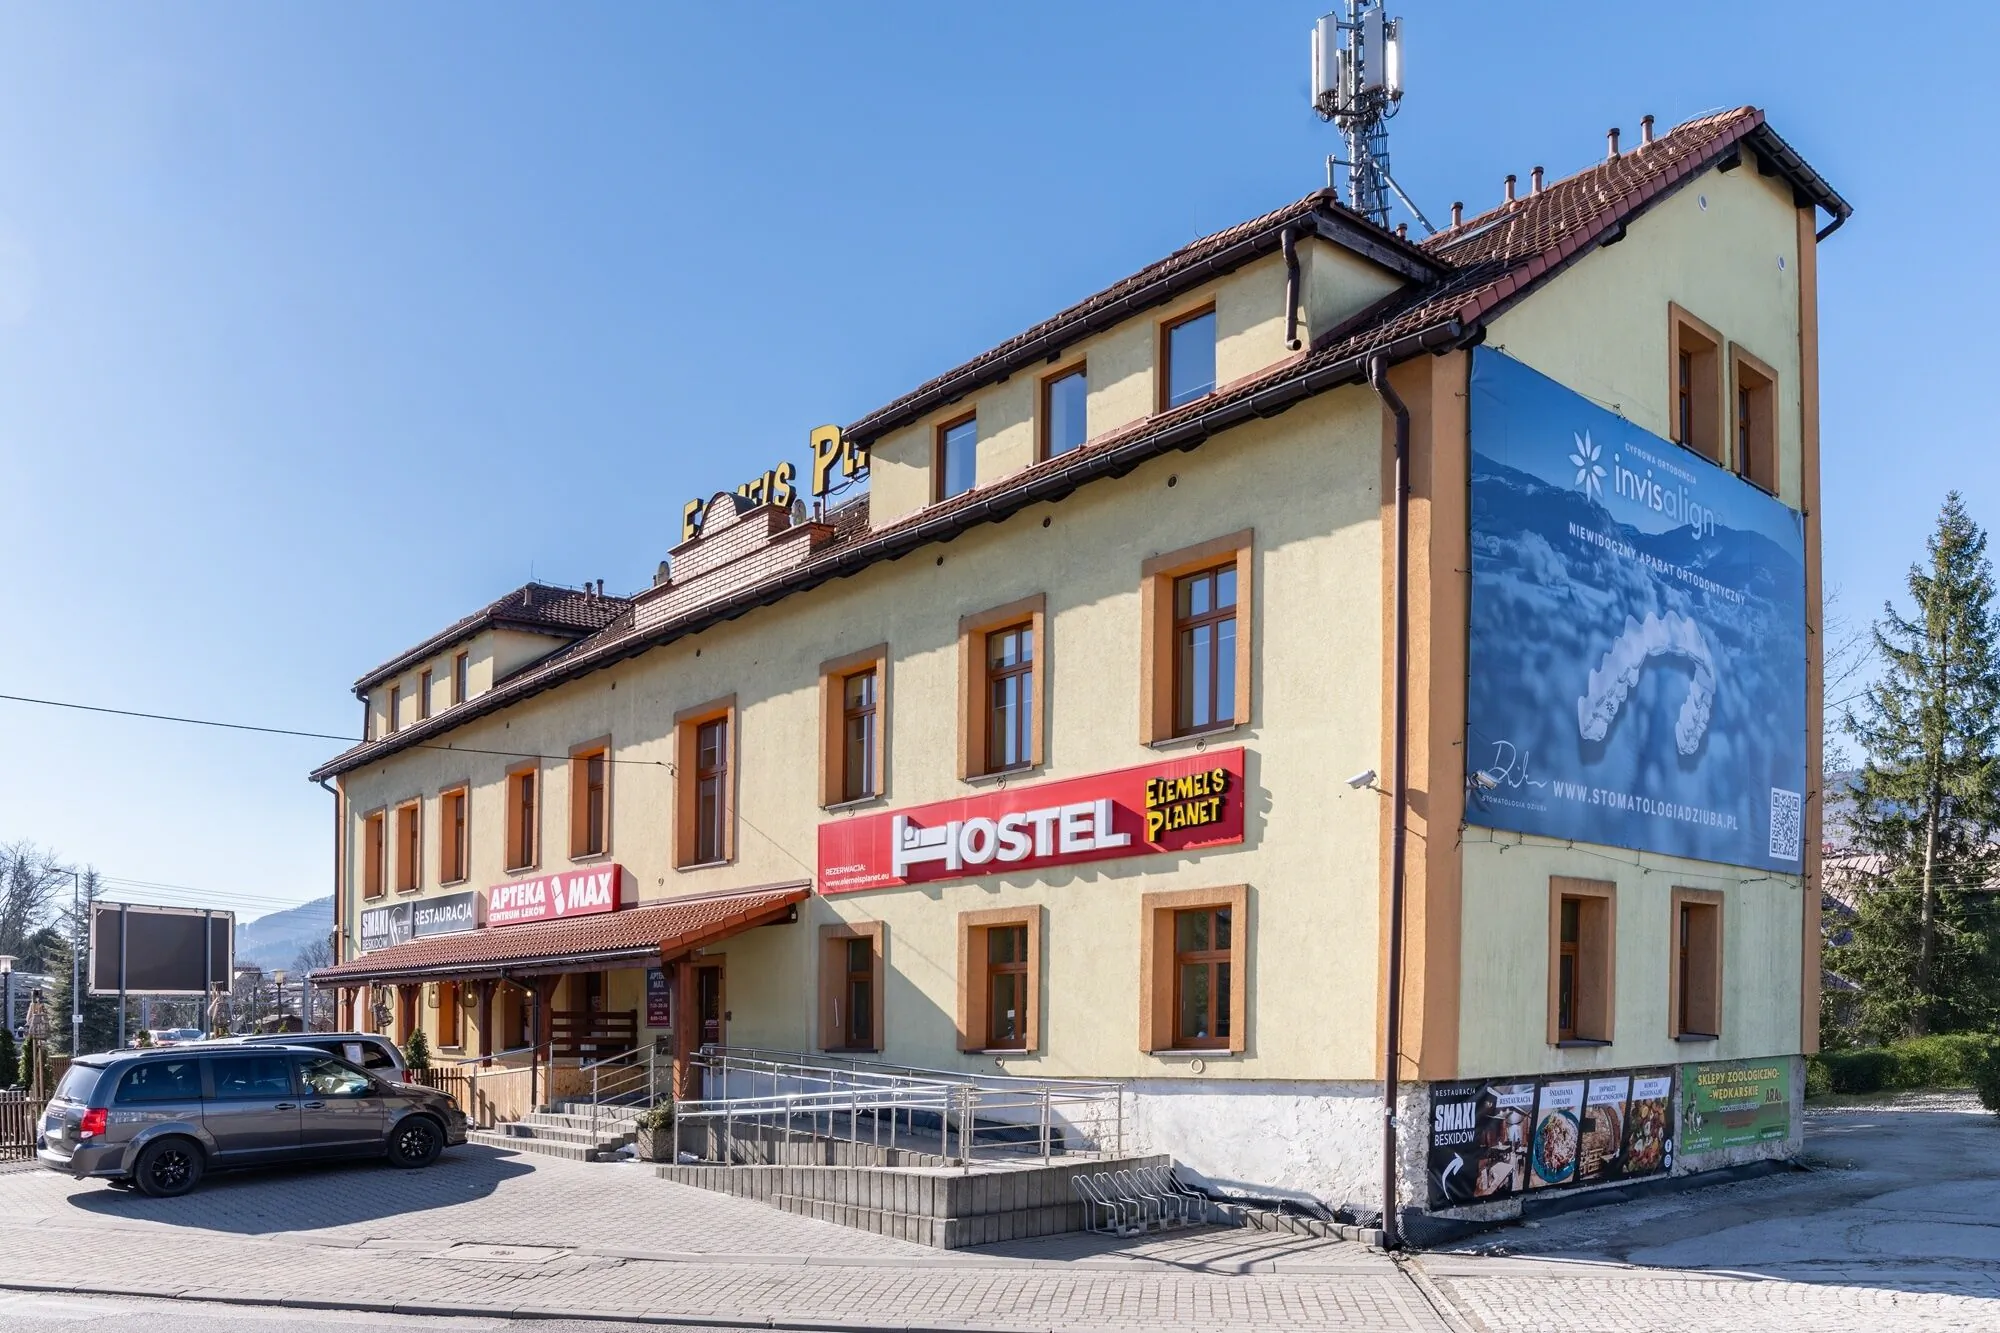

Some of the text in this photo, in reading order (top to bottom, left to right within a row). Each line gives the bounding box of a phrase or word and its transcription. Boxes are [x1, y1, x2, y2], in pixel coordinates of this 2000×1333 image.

[1625, 443, 1656, 465] CYFROWA
[1615, 453, 1715, 540] invisalign
[1569, 522, 1746, 606] NIEWIDOCZNY APARAT ORTODONTYCZNY
[1145, 768, 1226, 809] ELEMELS
[1147, 797, 1221, 842] PLANET
[1553, 780, 1739, 831] WWW.STOMATOLOGIADZIUBA.PL
[892, 799, 1131, 877] HOSTEL
[490, 872, 612, 910] APTEKA MAX
[362, 909, 389, 938] SMAKI
[414, 902, 473, 926] RESTAURACJA
[490, 904, 546, 922] CENTRUM LEKÓW
[1435, 1087, 1476, 1097] RESTAURACJA
[1698, 1071, 1726, 1086] SKLEPY
[1435, 1102, 1477, 1132] SMAKI
[1434, 1130, 1476, 1147] BESKIDÓW
